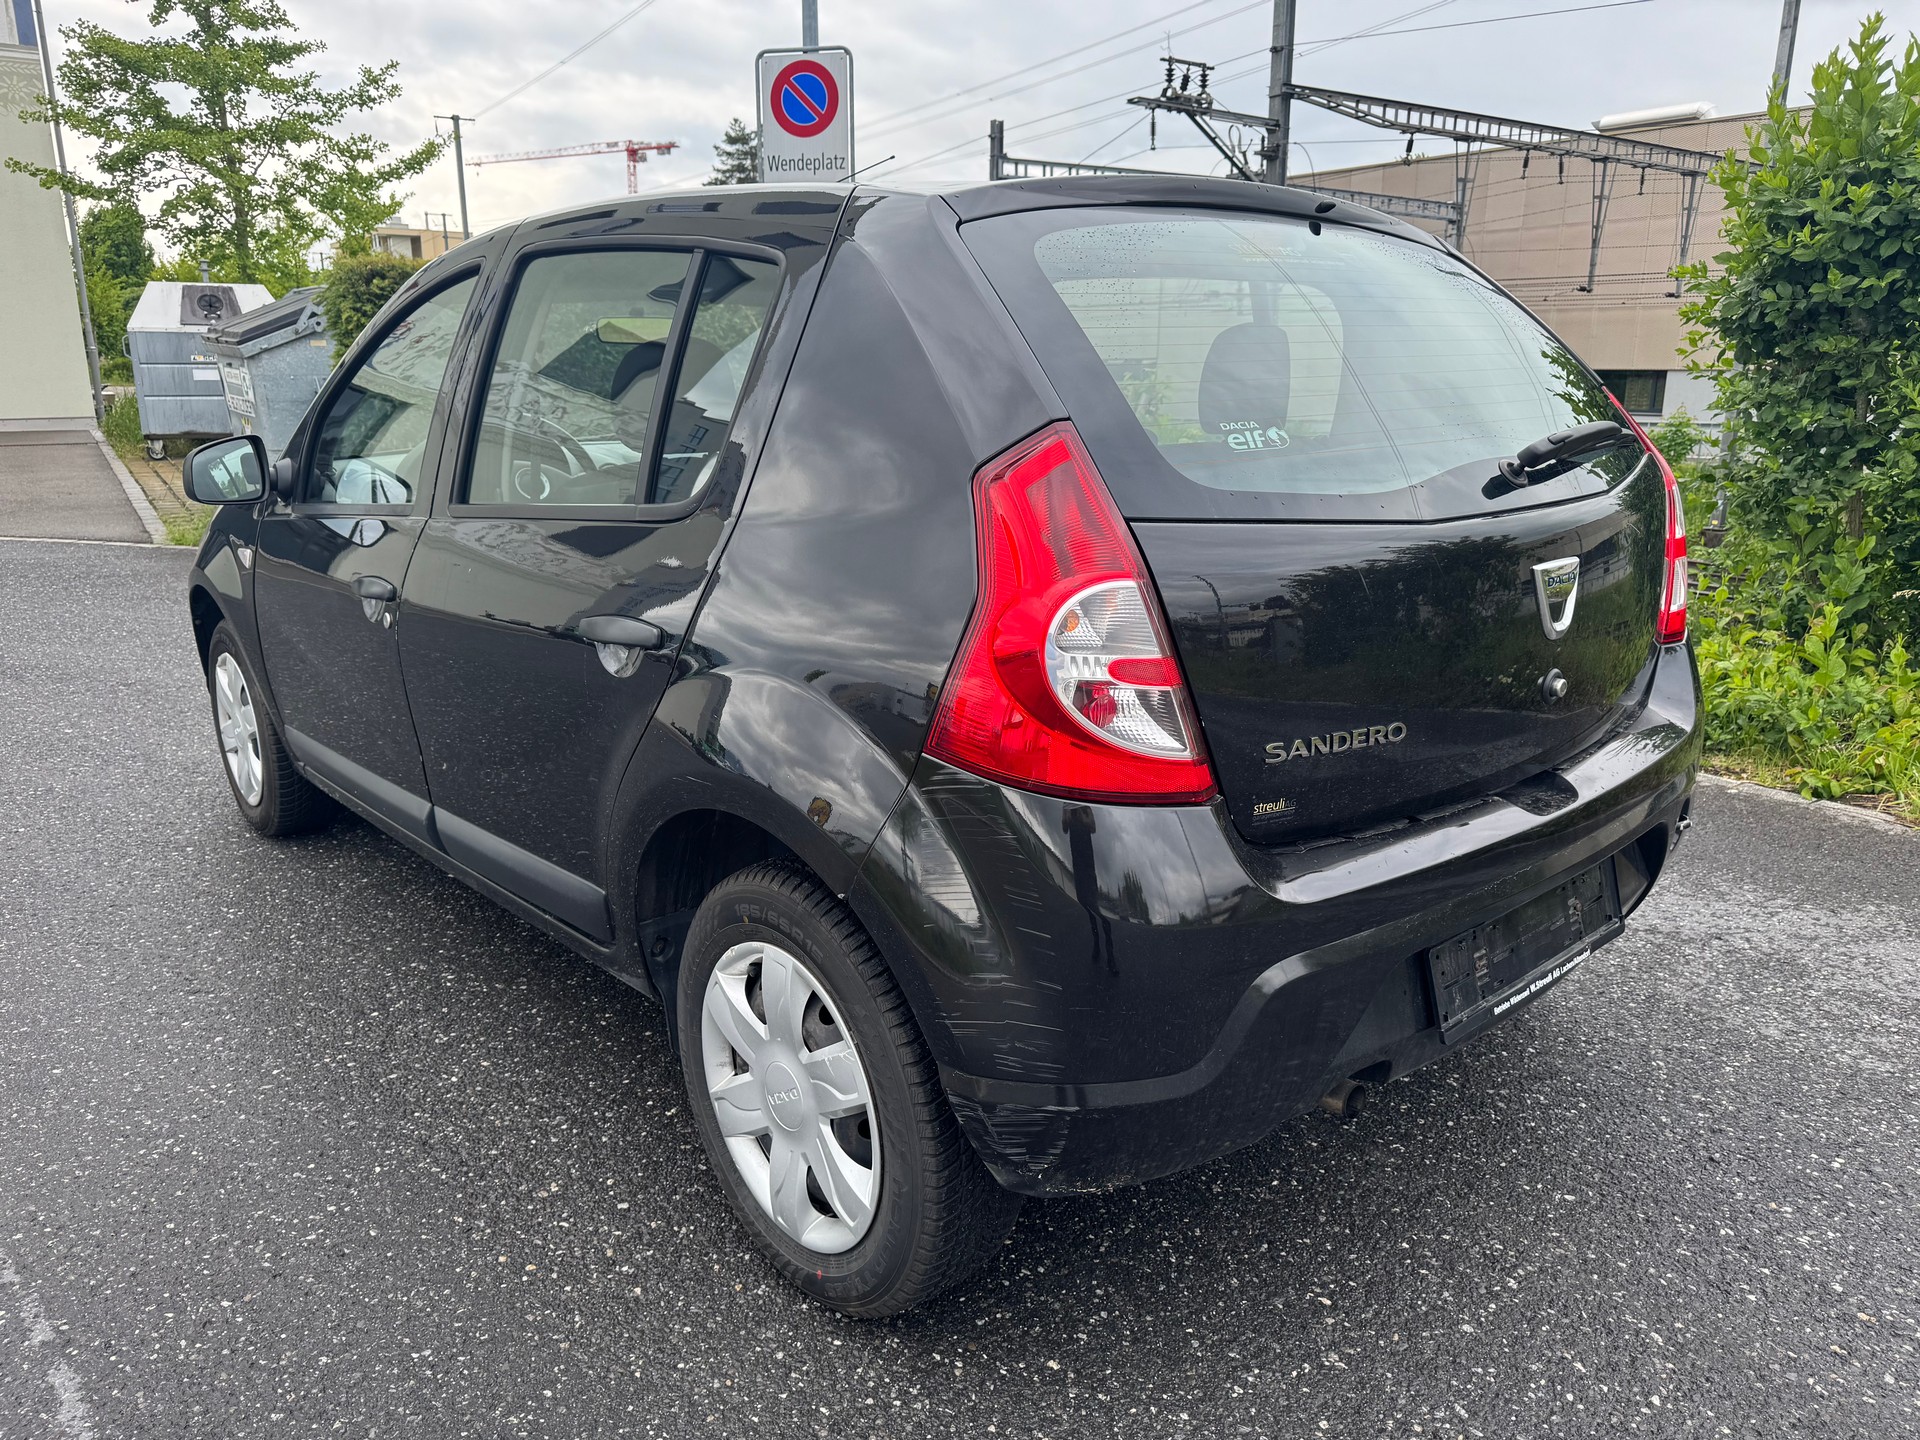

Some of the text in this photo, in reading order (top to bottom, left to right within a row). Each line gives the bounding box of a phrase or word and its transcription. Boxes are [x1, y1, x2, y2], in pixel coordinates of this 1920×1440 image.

[767, 152, 846, 175] Wendeplatz
[1220, 421, 1260, 430] DACIA
[1228, 430, 1266, 449] elf
[1547, 571, 1577, 587] DACIA
[1265, 722, 1407, 764] SANDERO
